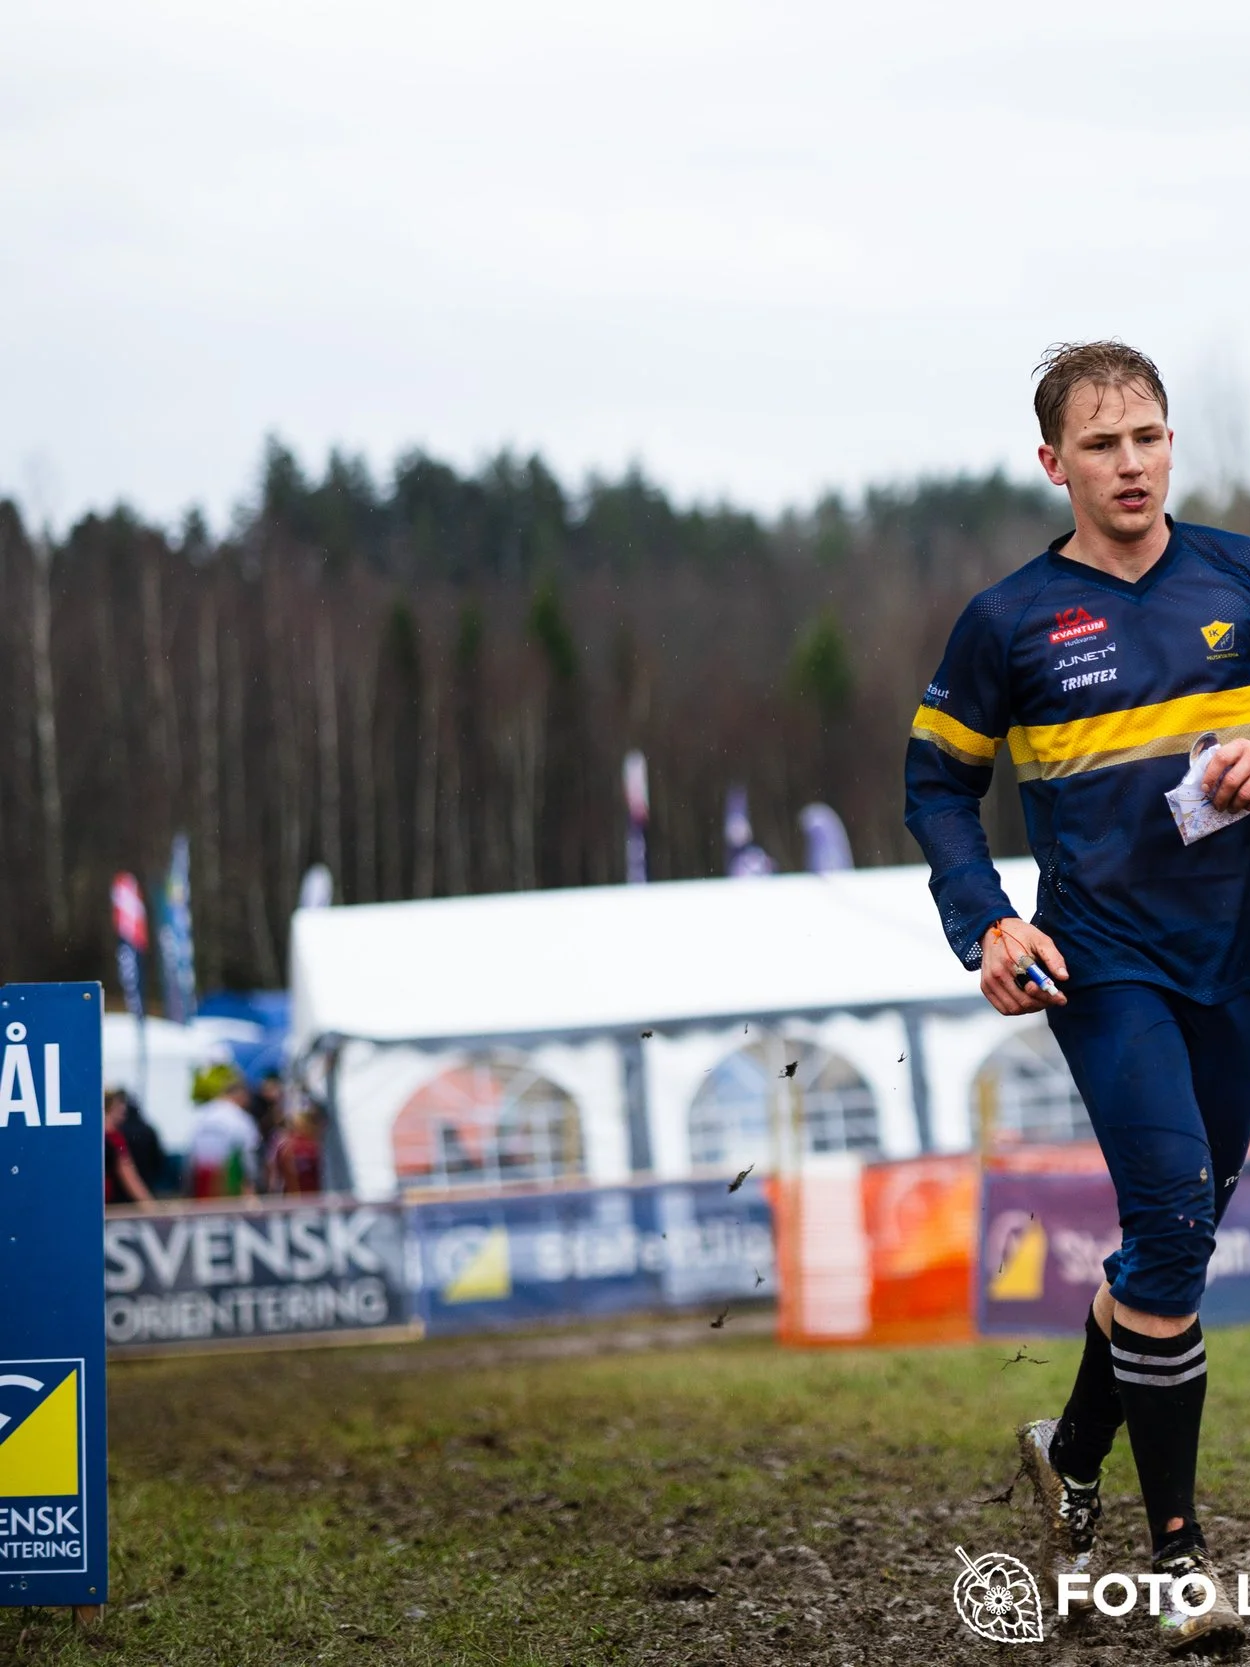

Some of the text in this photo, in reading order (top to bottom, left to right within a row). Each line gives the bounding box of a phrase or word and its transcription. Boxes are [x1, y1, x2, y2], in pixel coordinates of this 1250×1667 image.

[1055, 607, 1092, 628] ICA
[1051, 621, 1105, 641] KVANTUM
[1053, 649, 1109, 671] JUNET
[1061, 668, 1118, 692] TRIMTEX
[105, 1208, 382, 1293] SVENSK
[105, 1276, 389, 1343] ORIENTERING
